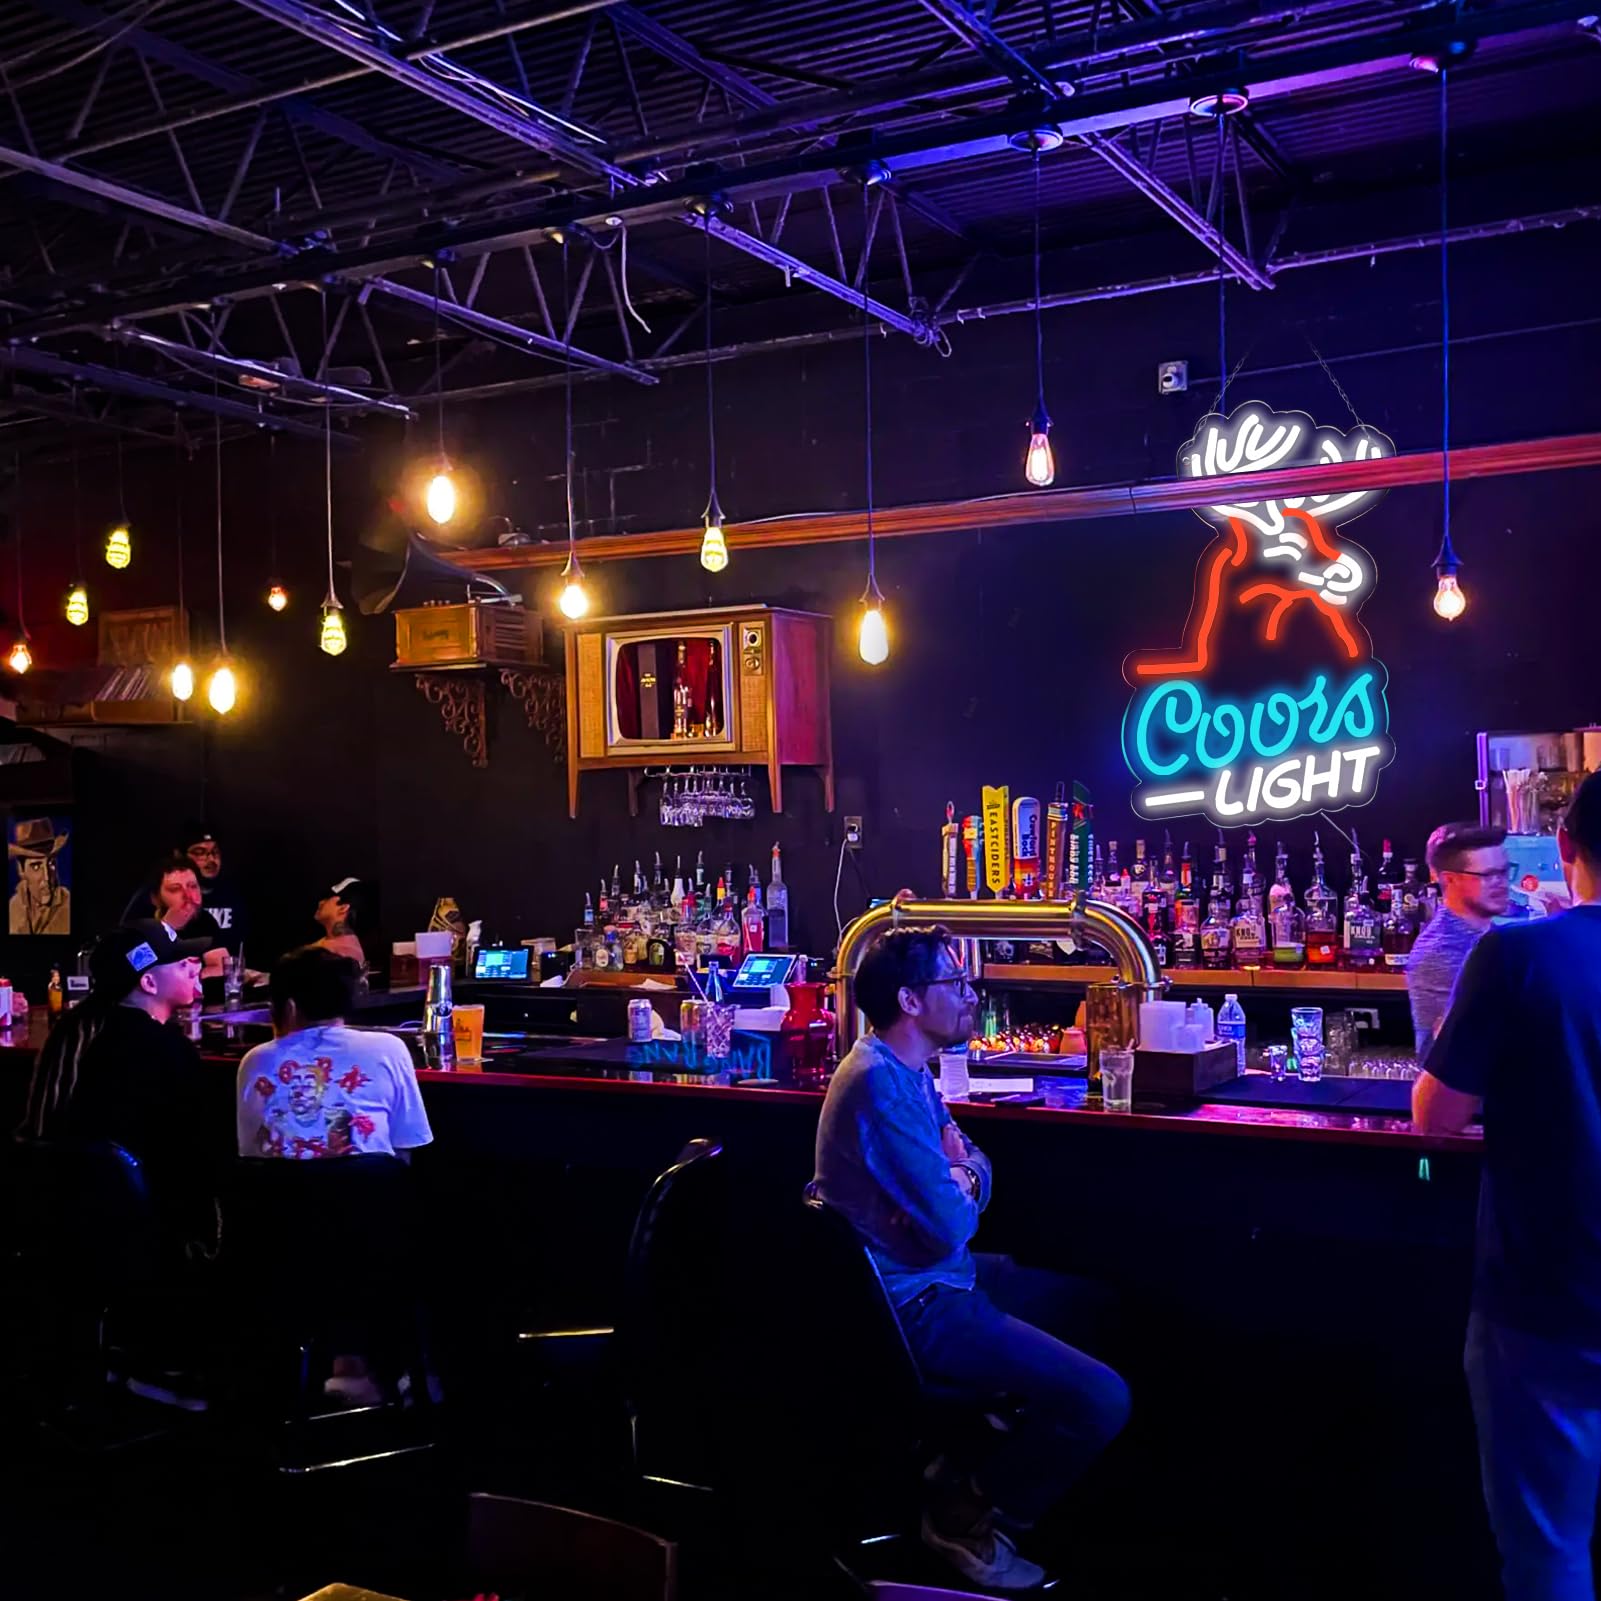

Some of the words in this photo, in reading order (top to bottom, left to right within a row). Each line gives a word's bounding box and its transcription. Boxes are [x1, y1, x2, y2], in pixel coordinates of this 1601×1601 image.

[1136, 673, 1375, 776] Coors
[1215, 746, 1380, 815] LIGHT
[989, 811, 1001, 885] EASTCIDERS
